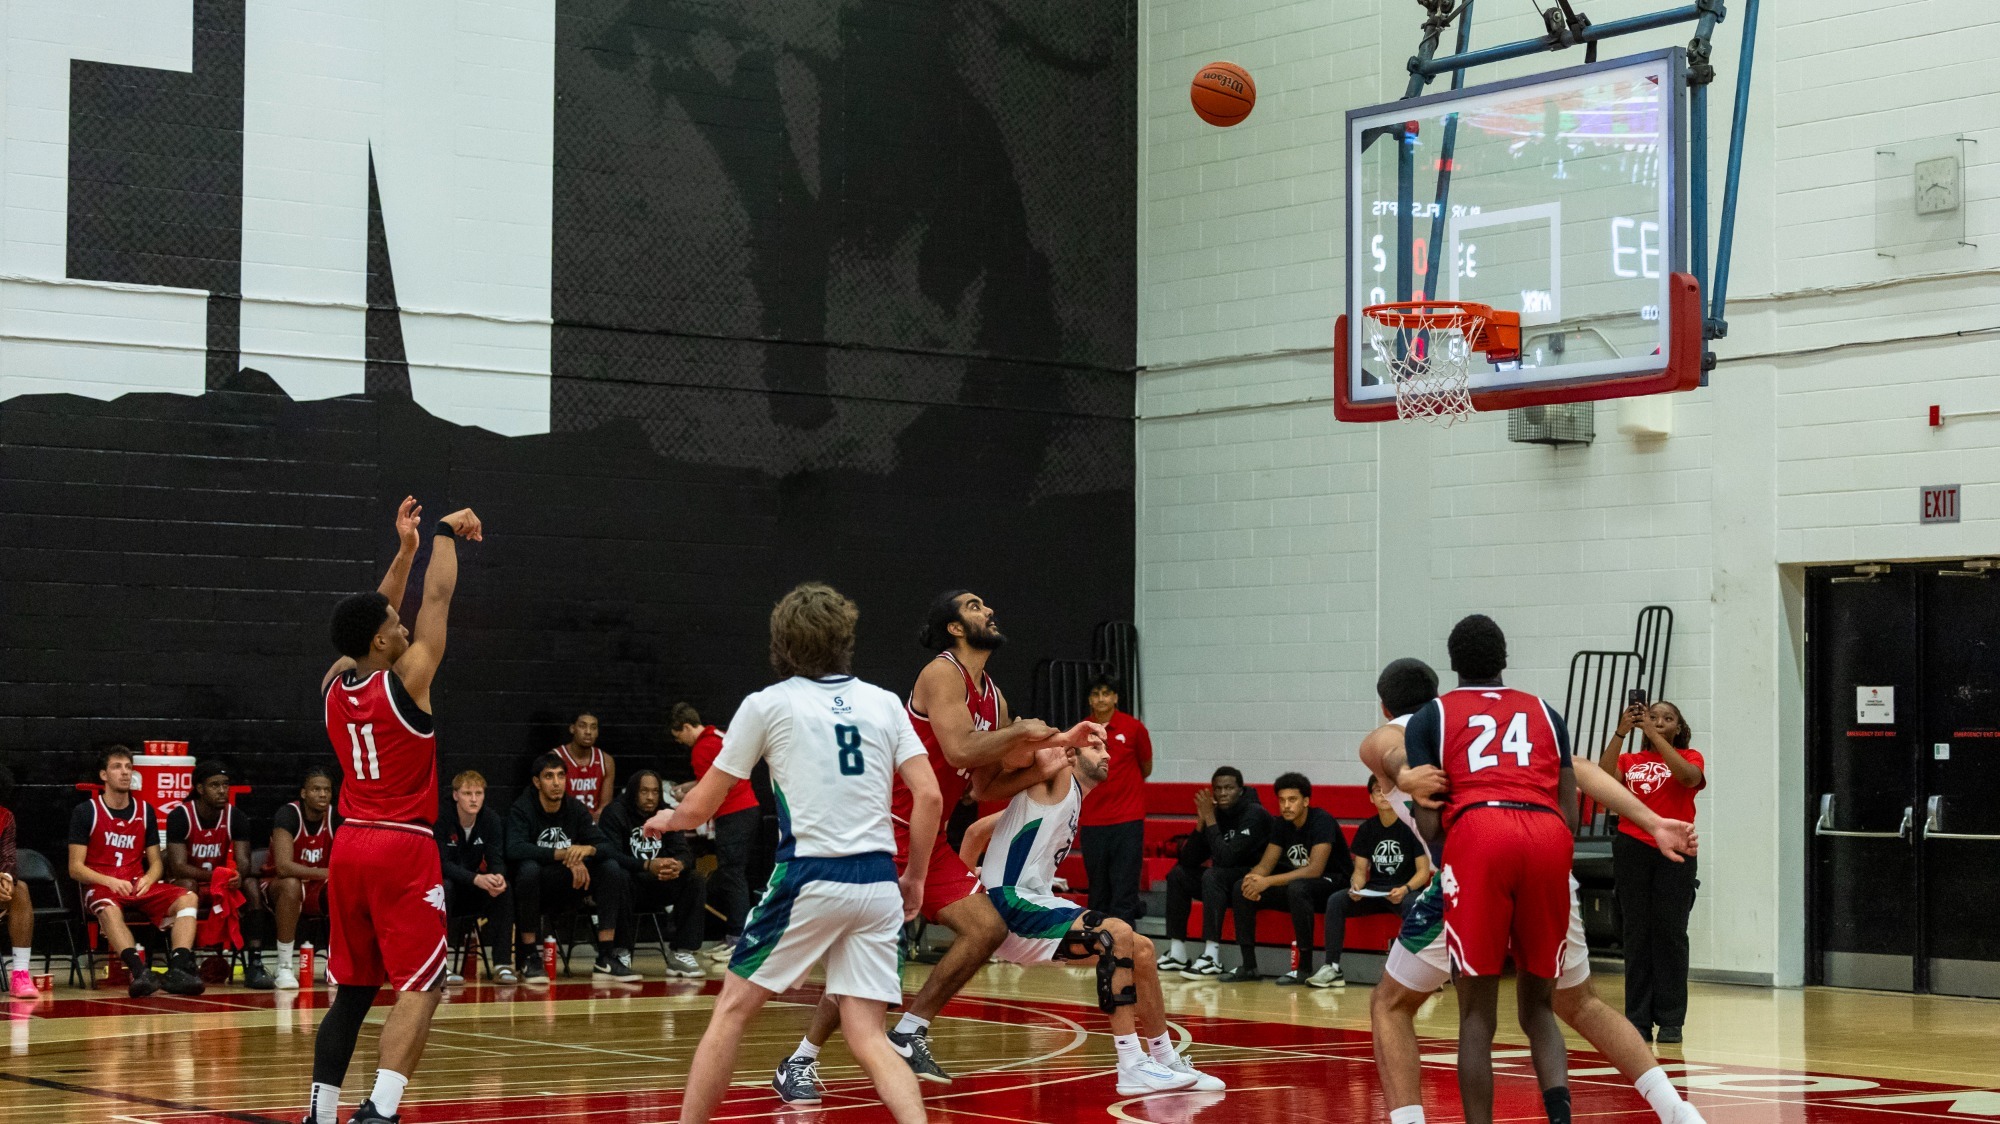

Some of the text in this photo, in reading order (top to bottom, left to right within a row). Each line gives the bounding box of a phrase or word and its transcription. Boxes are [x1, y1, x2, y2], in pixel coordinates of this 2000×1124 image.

[1203, 72, 1244, 95] Wilson
[1924, 489, 1957, 518] EXIT
[346, 722, 380, 780] 11
[834, 723, 865, 776] 8
[1467, 711, 1533, 774] 24
[157, 772, 192, 790] BIO
[570, 777, 598, 791] YORK
[157, 790, 189, 799] STEE
[104, 830, 136, 850] YORK
[192, 842, 222, 858] YORK
